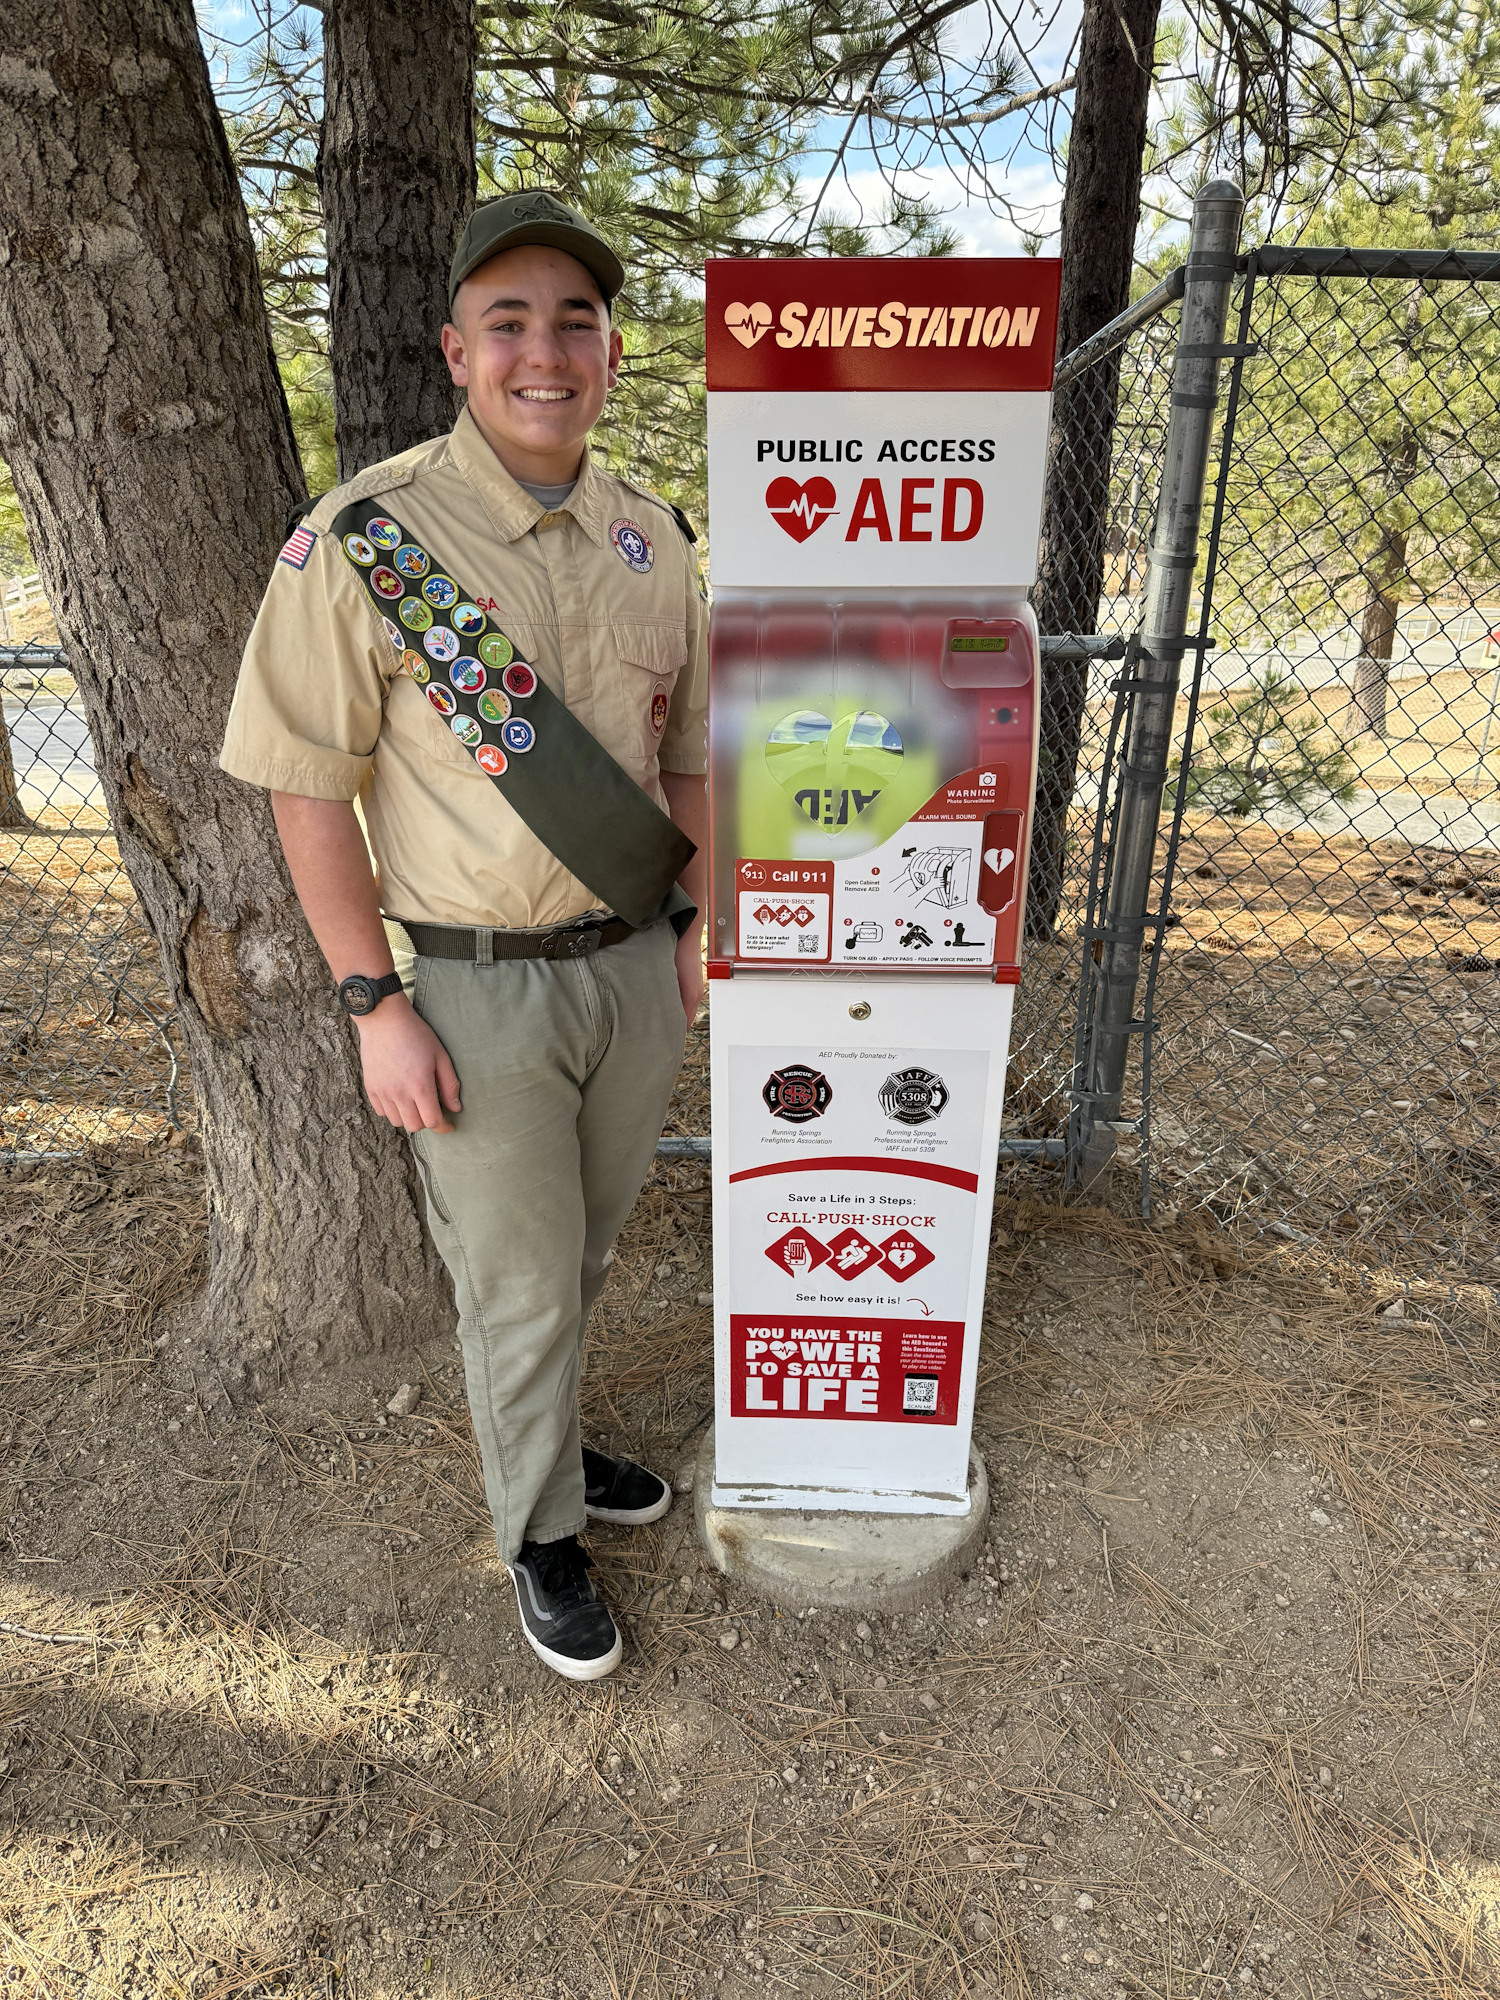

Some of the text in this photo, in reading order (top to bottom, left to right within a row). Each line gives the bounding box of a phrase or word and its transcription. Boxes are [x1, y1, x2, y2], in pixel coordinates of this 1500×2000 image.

[757, 440, 996, 462] PUBLIC ACCESS
[845, 478, 984, 542] AED
[476, 597, 500, 612] SA
[947, 789, 996, 798] WARNING
[745, 871, 764, 880] 911
[772, 871, 827, 882] Call 911
[899, 1072, 932, 1081] IAFF
[901, 1092, 927, 1102] 5308
[788, 1194, 817, 1203] Save
[830, 1194, 851, 1203] Life
[854, 1195, 865, 1204] in
[879, 1196, 916, 1206] Steps:
[791, 1243, 803, 1257] 911
[796, 1294, 816, 1302] See
[848, 1296, 873, 1305] easy
[888, 1296, 901, 1304] is!
[746, 1328, 882, 1342] YOU HAVE THE
[746, 1362, 880, 1379] TO SAVE A
[746, 1377, 879, 1413] LIFE
